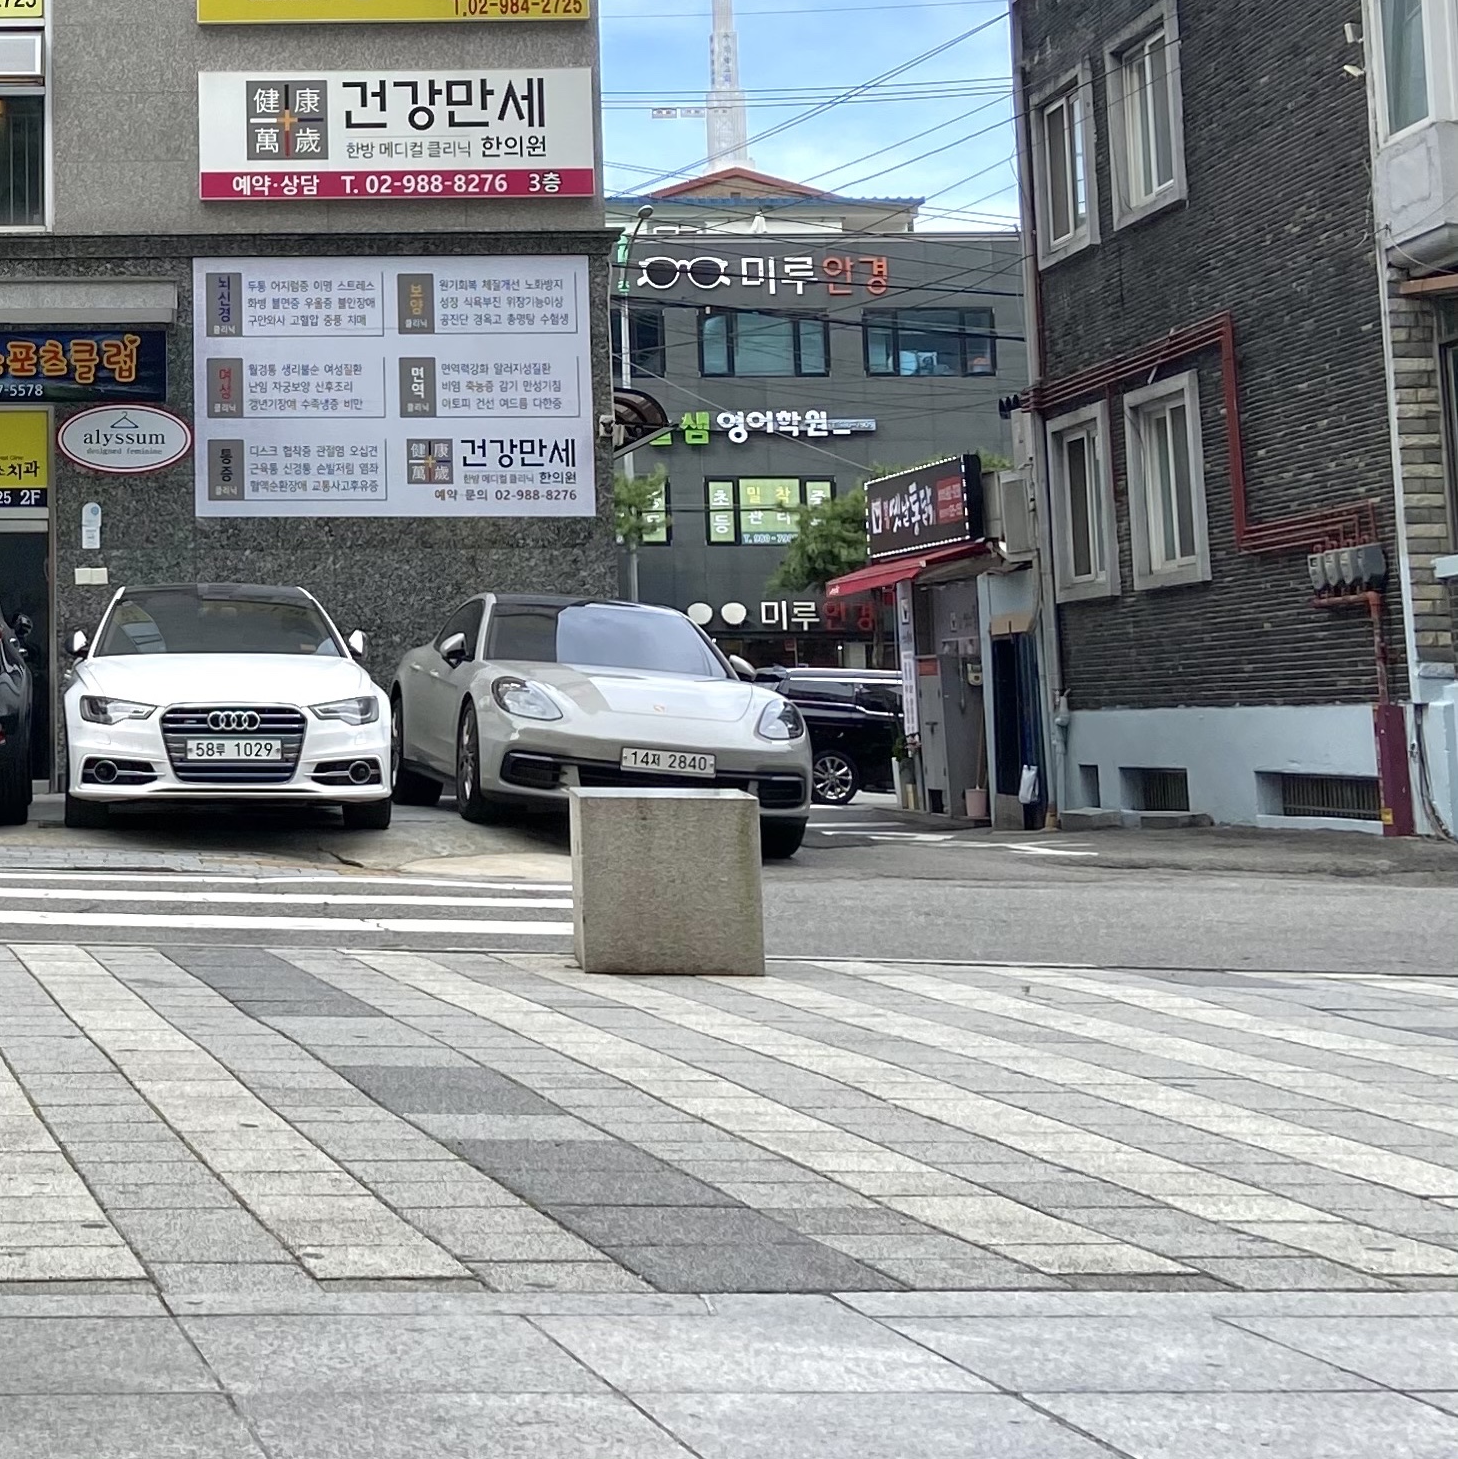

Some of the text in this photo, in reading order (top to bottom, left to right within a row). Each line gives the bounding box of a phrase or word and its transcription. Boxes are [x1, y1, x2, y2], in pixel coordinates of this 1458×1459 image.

[342, 78, 545, 130] 건강만세
[346, 135, 546, 159] 한방 메디컬 클리닉 한의원
[366, 174, 508, 193] 02-988-8276
[529, 171, 562, 193] 3층
[248, 281, 266, 292] 두통
[337, 281, 376, 291] 스트레스
[83, 430, 166, 446] alyssum
[250, 446, 277, 457] 디스크
[461, 438, 576, 468] 건강만세
[539, 471, 577, 484] 한의원
[20, 490, 41, 505] 2F
[495, 490, 577, 501] 02-988-8276
[196, 742, 273, 757] 58루 1029
[668, 754, 707, 771] 2840
